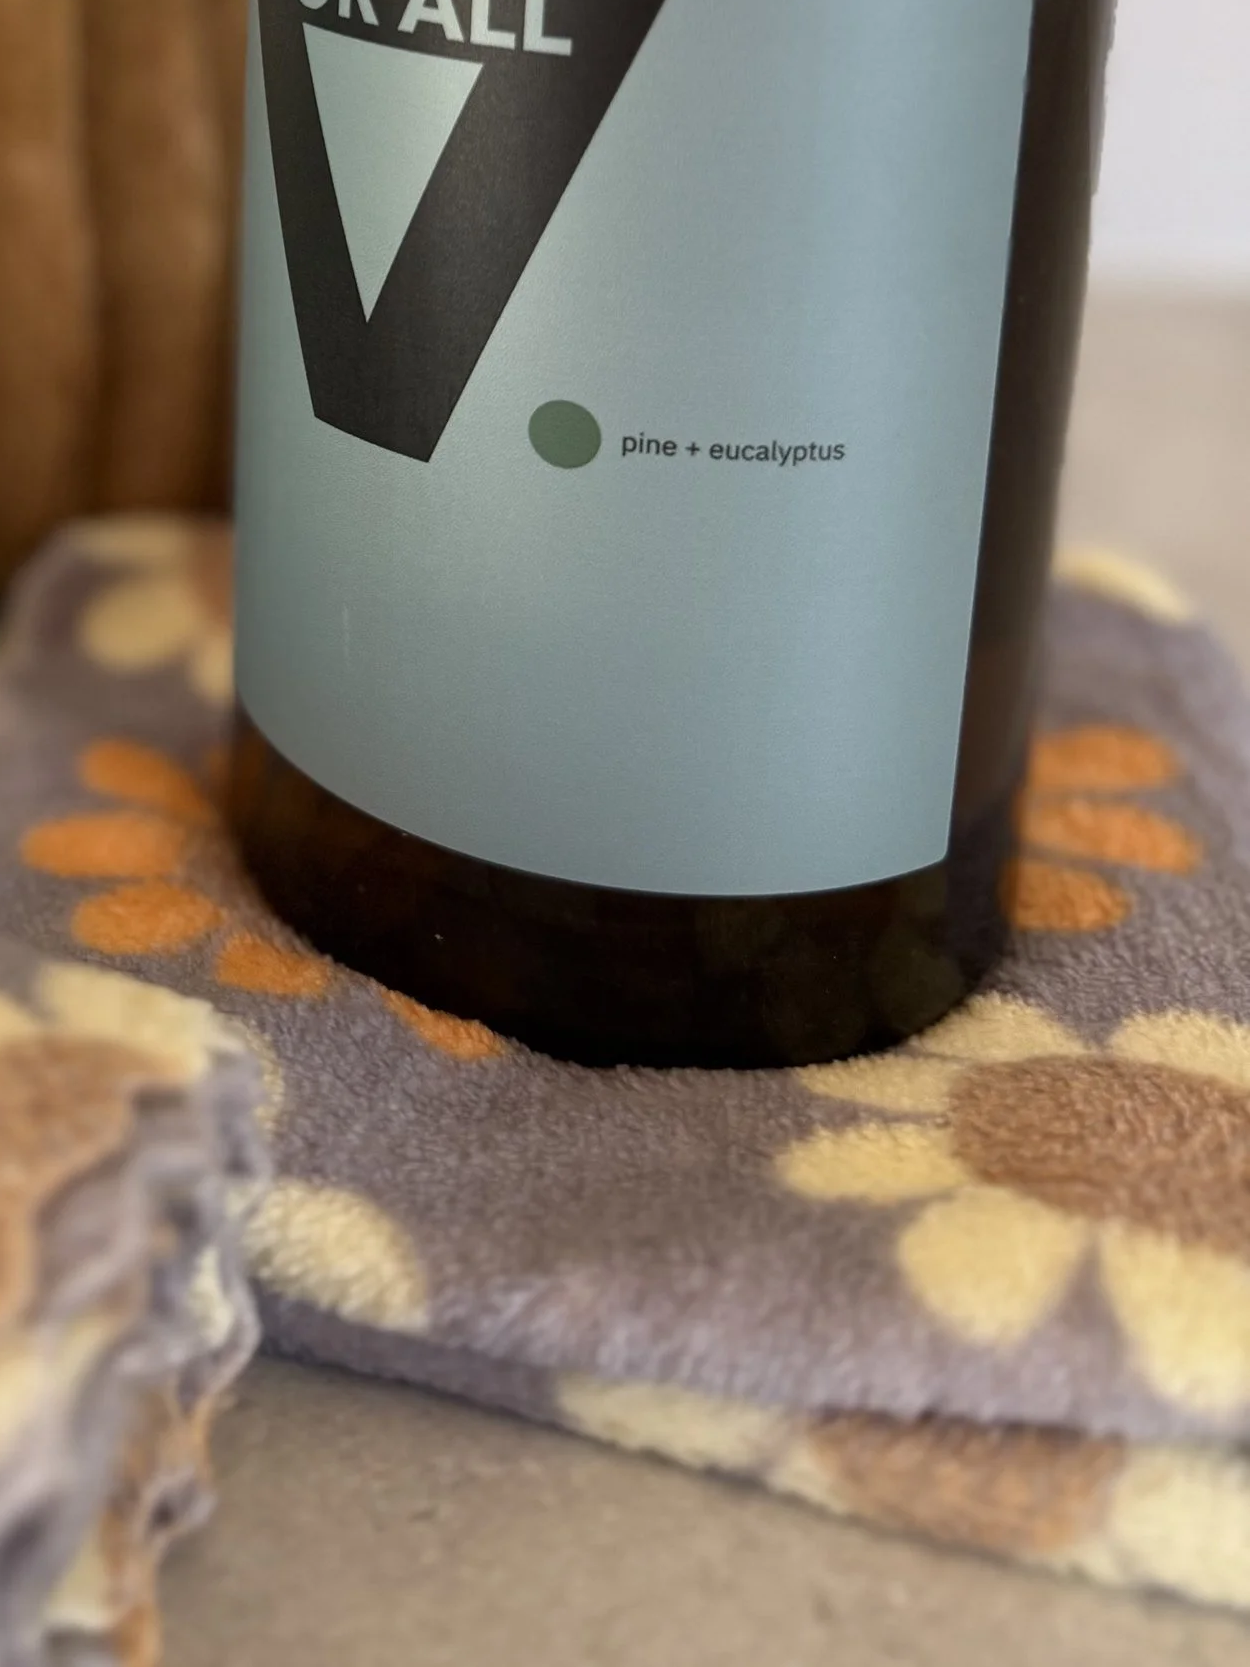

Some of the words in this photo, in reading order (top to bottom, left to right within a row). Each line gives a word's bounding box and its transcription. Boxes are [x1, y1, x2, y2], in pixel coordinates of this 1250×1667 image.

[621, 431, 678, 458] pine
[685, 441, 701, 457] +
[708, 439, 846, 467] eucalyptus
